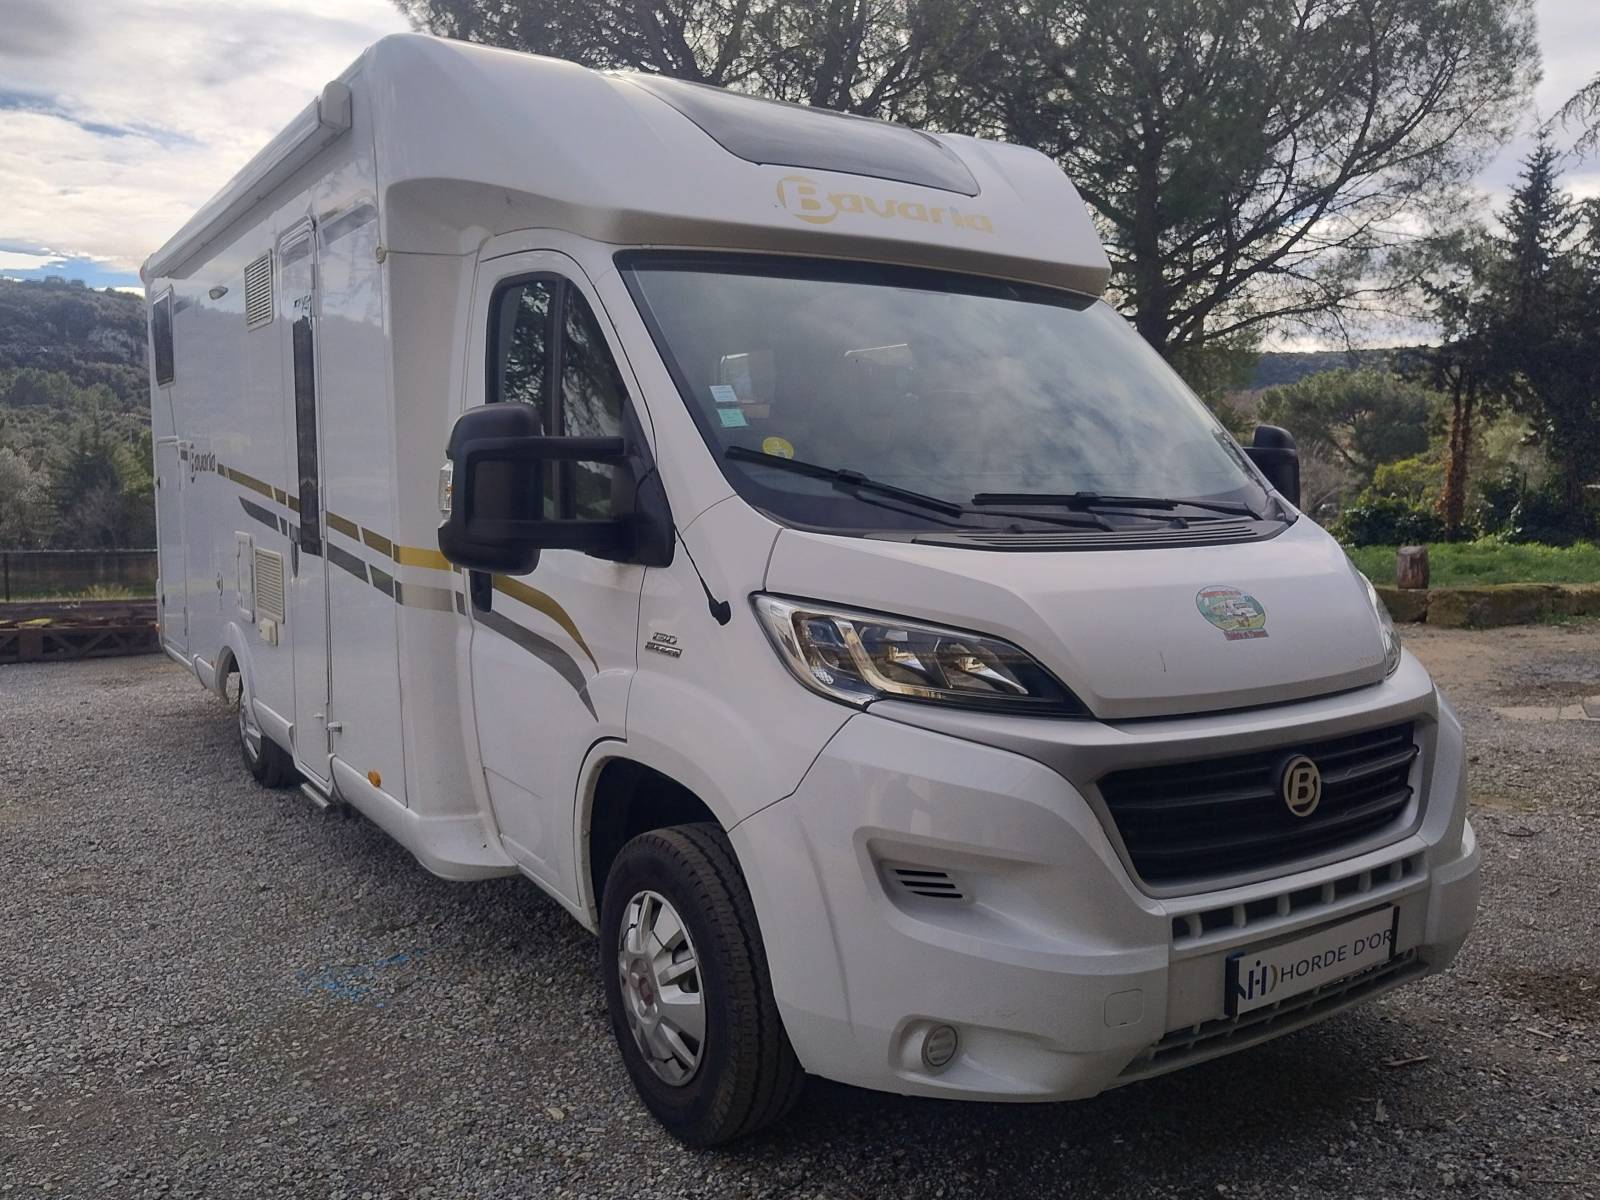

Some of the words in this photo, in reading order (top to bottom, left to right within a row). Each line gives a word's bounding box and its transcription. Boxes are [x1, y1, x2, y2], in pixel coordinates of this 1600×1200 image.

[776, 176, 994, 234] Bavaria
[1287, 761, 1318, 810] B
[1280, 945, 1347, 983] HORDE
[1353, 928, 1394, 956] D'OR
